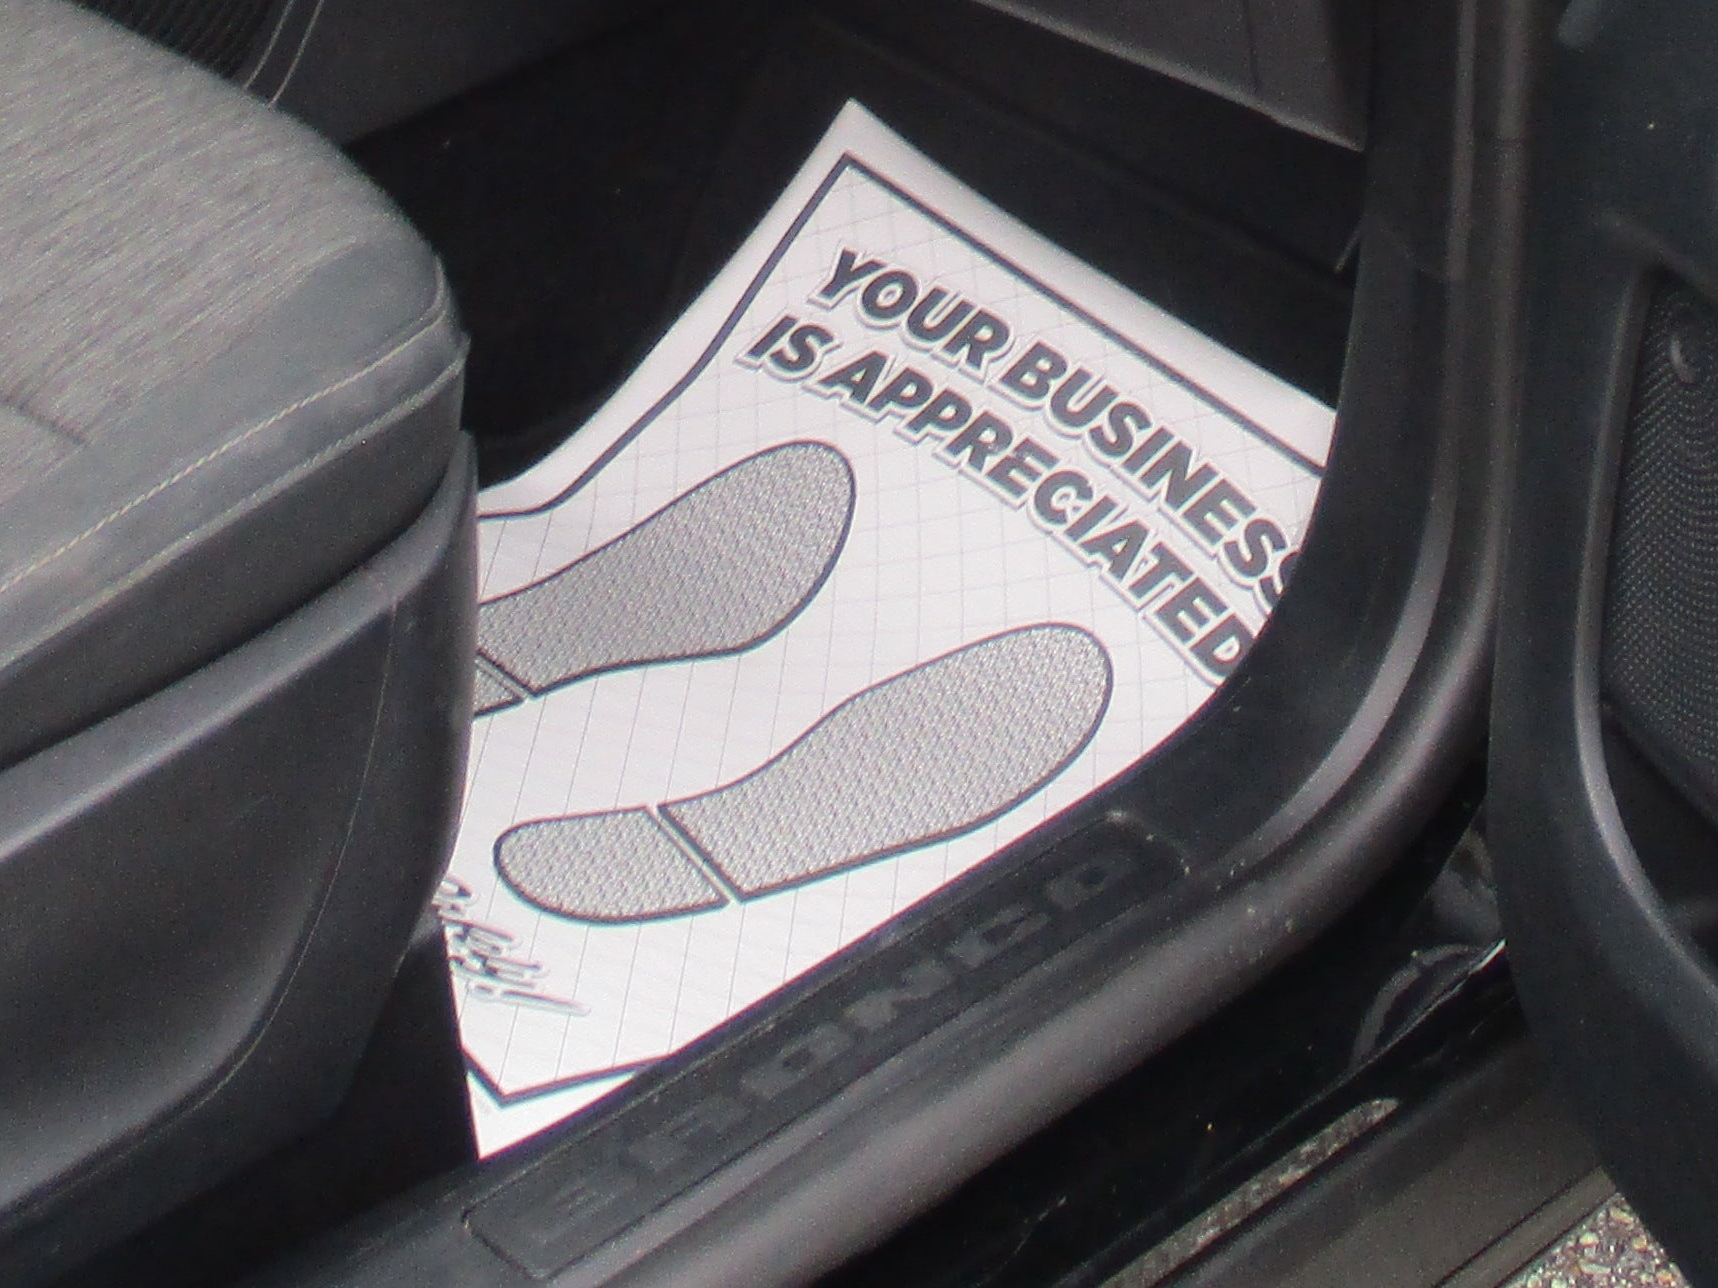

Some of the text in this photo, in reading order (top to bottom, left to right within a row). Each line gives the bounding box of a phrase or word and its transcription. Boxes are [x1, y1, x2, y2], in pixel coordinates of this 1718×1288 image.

[813, 247, 1013, 375] YOUR
[745, 315, 1257, 678] IS APPRECIATED
